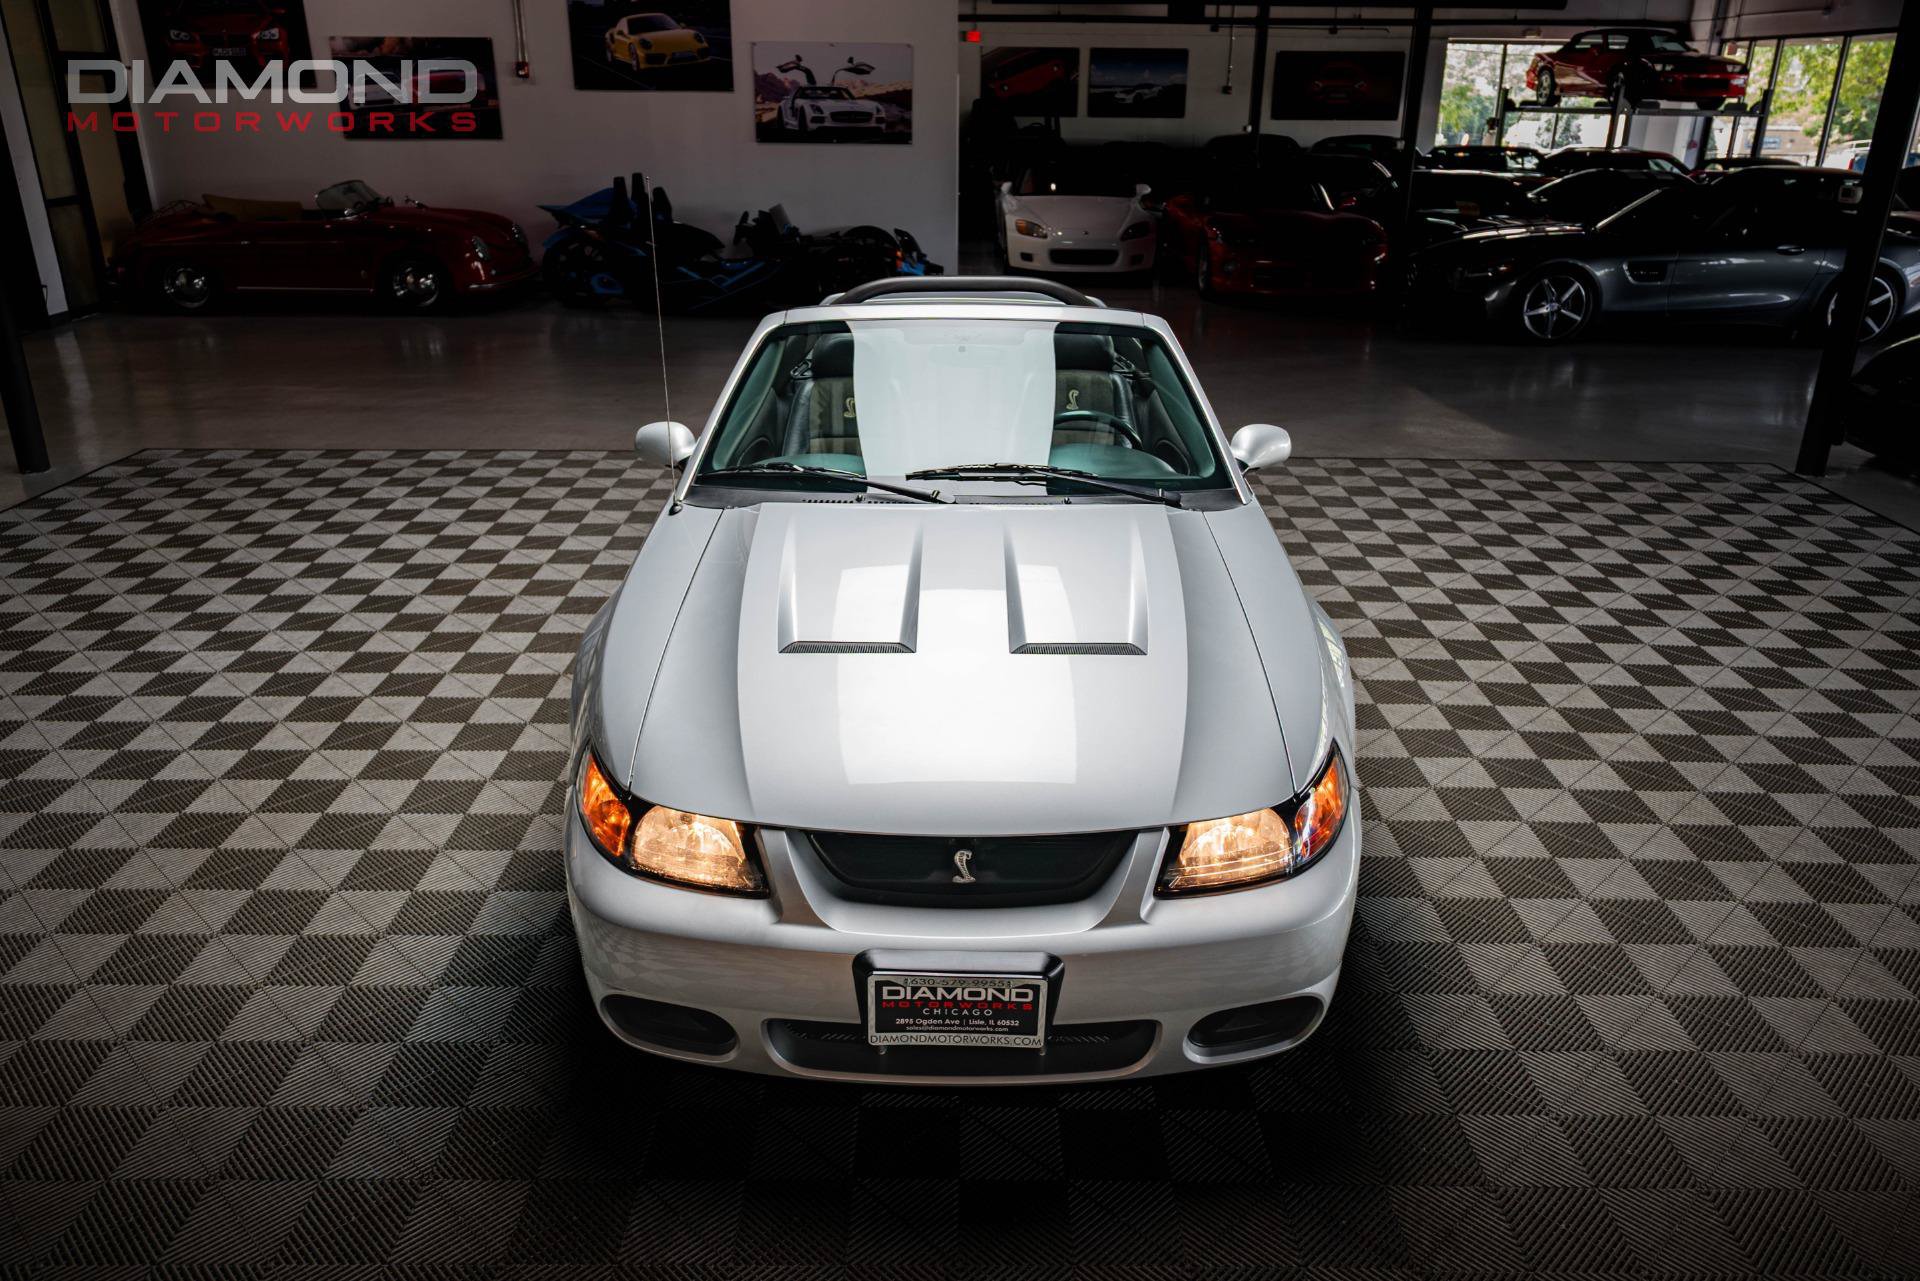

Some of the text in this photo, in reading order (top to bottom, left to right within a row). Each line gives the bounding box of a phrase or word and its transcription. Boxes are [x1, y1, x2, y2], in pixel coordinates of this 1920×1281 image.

[882, 986, 1034, 1002] DIAMOND
[881, 1001, 1033, 1010] MOTORWORKS
[922, 1008, 993, 1016] CHICAGO
[915, 1018, 943, 1026] Ogden
[870, 1034, 1042, 1046] DIAMONDMOTORWORKS.COM
